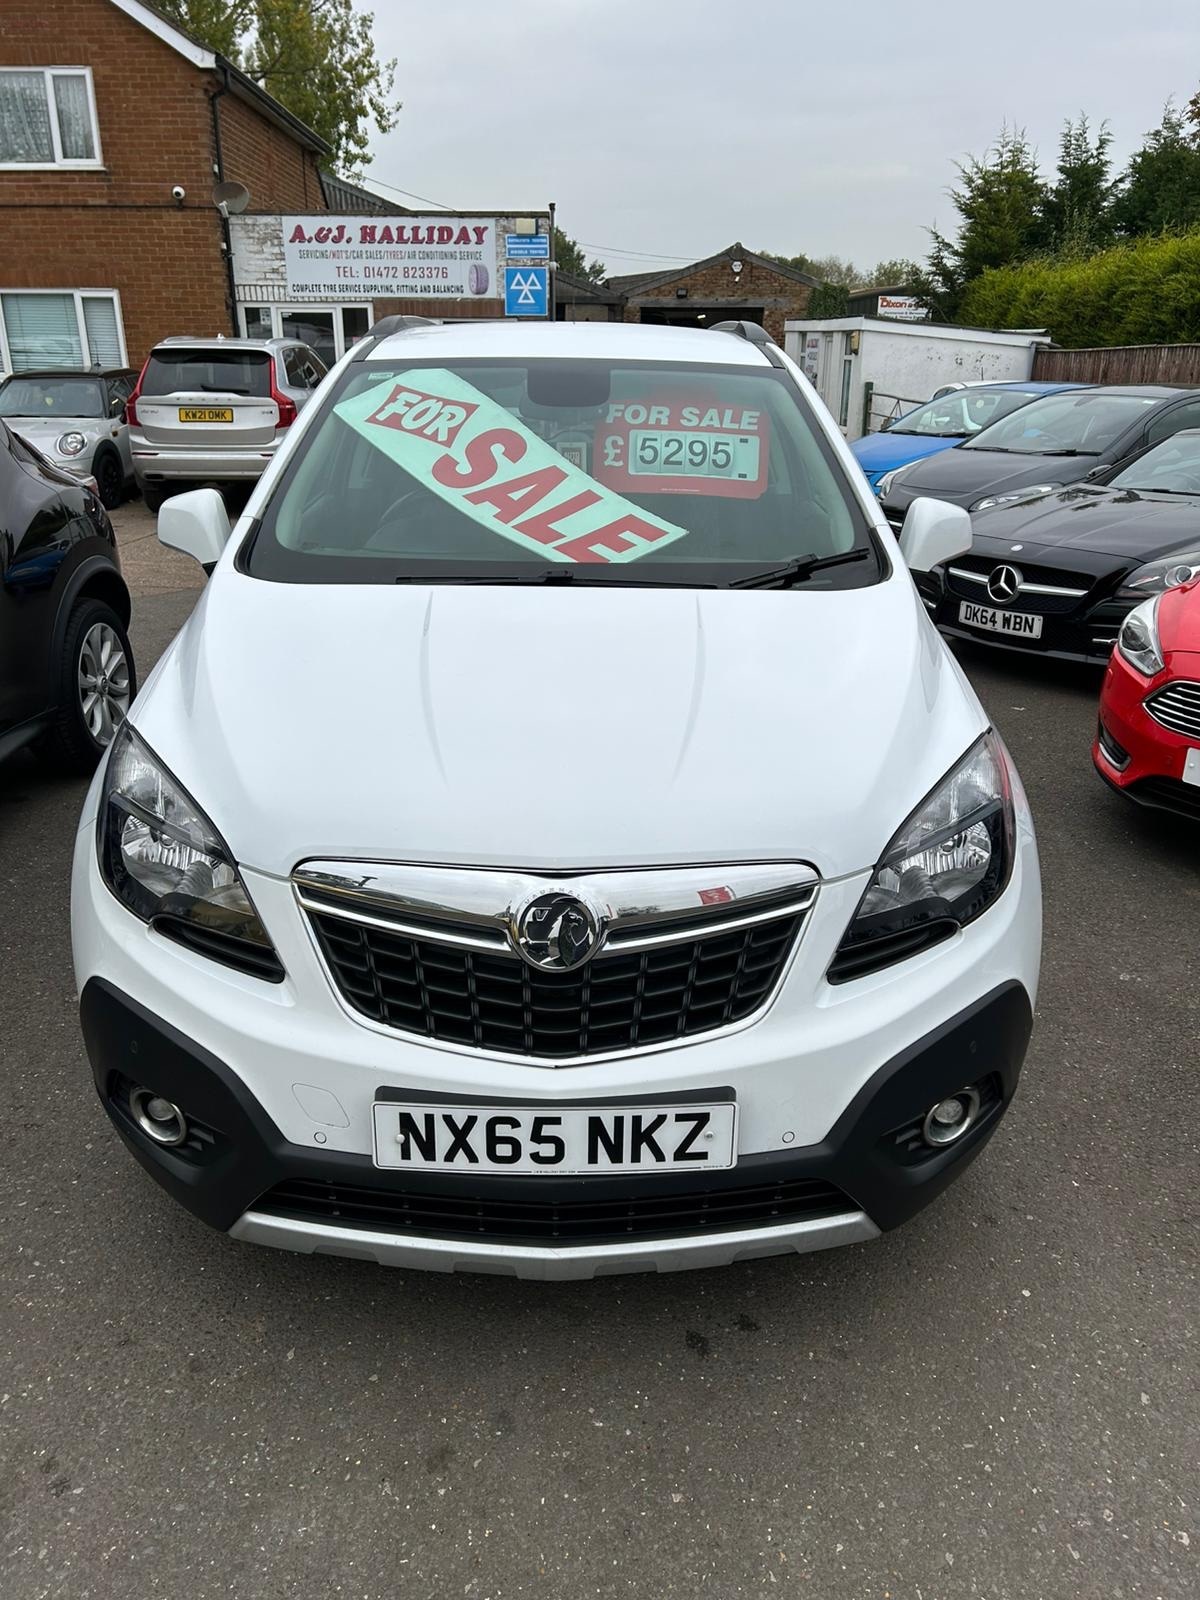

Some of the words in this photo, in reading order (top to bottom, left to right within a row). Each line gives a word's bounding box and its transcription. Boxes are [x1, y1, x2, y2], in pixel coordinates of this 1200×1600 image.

[359, 224, 488, 245] HALLIDAY
[418, 250, 457, 260] CONDITIONING
[459, 251, 482, 260] SERVICE
[336, 266, 359, 278] TEL:
[364, 266, 398, 278] 01472
[403, 266, 448, 279] 823376
[292, 283, 321, 293] COMPLETE
[323, 283, 337, 293] TYRE
[338, 284, 361, 293] SERVICE
[363, 284, 395, 295] SUPPLYING,
[397, 285, 418, 294] FITTING
[420, 285, 432, 294] AND
[433, 285, 464, 294] BALANCING
[185, 411, 206, 420] KW21
[209, 411, 227, 420] OMK
[606, 404, 670, 425] FOR
[680, 406, 760, 430] SALE
[604, 435, 624, 467] £
[639, 437, 731, 469] 5295
[376, 391, 467, 442] FOR
[431, 427, 669, 563] SALE
[964, 604, 997, 627] DK64
[1002, 613, 1035, 633] WBN
[398, 1111, 566, 1165] NX65
[587, 1111, 711, 1164] NKZ
